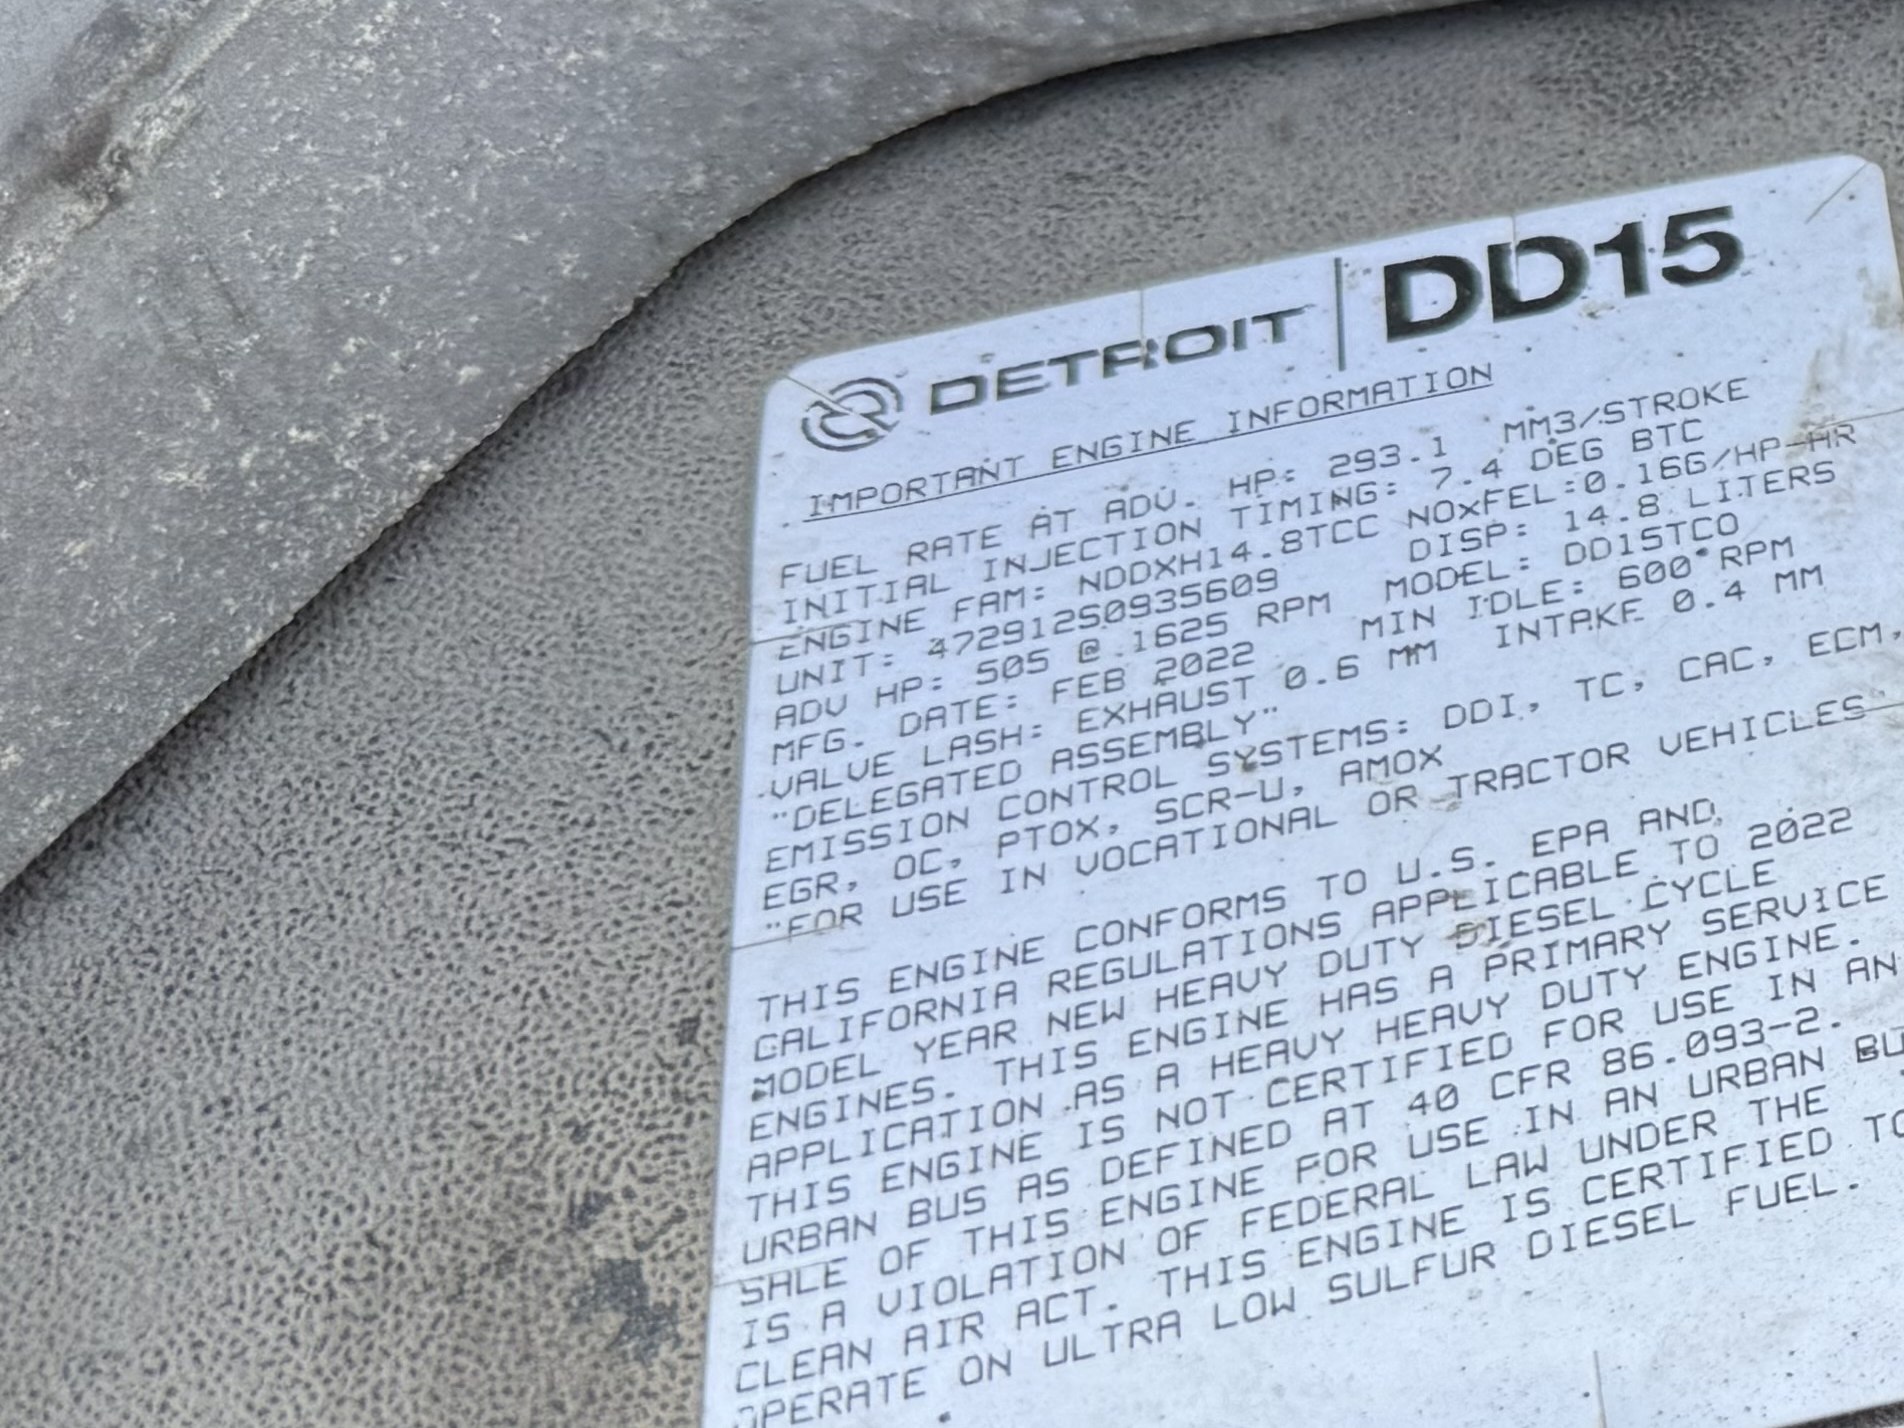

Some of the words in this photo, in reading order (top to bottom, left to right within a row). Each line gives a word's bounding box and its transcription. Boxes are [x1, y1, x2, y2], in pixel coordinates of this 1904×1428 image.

[929, 302, 1310, 417] DETROIT
[1382, 203, 1747, 344] DD15
[780, 552, 878, 589] FUEL
[906, 523, 1001, 566] RATE
[1030, 506, 1075, 539] AT
[1228, 467, 1294, 498] HP:
[1328, 434, 1446, 479] 293.1
[1503, 375, 1748, 444] MM3/STROKE
[783, 571, 950, 625] INITIAL
[984, 515, 1201, 582] INJECTION
[1430, 456, 1503, 491] 7.4
[1528, 435, 1603, 472] DEG
[1630, 417, 1703, 453] BTC
[807, 453, 1023, 520] IMPORTANT
[1052, 418, 1195, 469] ENGINE
[1228, 361, 1491, 434] INFORMATION
[772, 726, 864, 765] MFG.
[899, 692, 1016, 738] DATE:
[1052, 666, 1125, 705] FEB
[1152, 639, 1253, 687] 2022
[1360, 603, 1434, 641] MIN
[1617, 553, 1692, 591] 600
[1719, 534, 1794, 571] RPM
[774, 693, 846, 730] ADV
[875, 674, 941, 708] HP:
[1256, 590, 1330, 628] RPM
[776, 650, 892, 696] UNIT:
[1408, 521, 1526, 564] DISP:
[1565, 492, 1659, 533] 14.8
[953, 585, 1043, 622] FAM:
[1078, 512, 1378, 596] NDDXH14.8TCC
[764, 805, 968, 873] EMISSION
[998, 764, 1176, 822] CONTROL
[1443, 691, 1539, 731] DDI,
[1574, 670, 1643, 702] TC,
[1678, 644, 1773, 683] CAC,
[1807, 620, 1901, 658] ECM,
[771, 750, 894, 801] VALVE
[922, 722, 1041, 767] LASH:
[1077, 673, 1254, 735] EXHAUST
[1284, 653, 1359, 691] 0.6
[1671, 578, 1746, 614] 0.4
[1773, 563, 1823, 595] MM
[756, 975, 859, 1023] THIS
[889, 934, 1044, 995] ENGINE
[1075, 883, 1286, 954] CONFORMS
[1316, 867, 1366, 901] TO
[1396, 844, 1495, 886] U.S.
[1530, 817, 1609, 859] EPA
[762, 869, 857, 911] EGR,
[893, 846, 960, 881] OC,
[997, 813, 1118, 859] PTOX,
[1154, 775, 1303, 826] SCR-U,
[1339, 742, 1442, 787] AMOX
[891, 877, 966, 919] USE
[1000, 860, 1045, 895] IN
[1075, 804, 1337, 877] VOCATIONAL
[1366, 783, 1417, 818] OR
[1048, 909, 1341, 998] REGULATIONS
[1668, 832, 1719, 866] TO
[1747, 805, 1852, 852] 2022
[746, 1091, 1041, 1184] APPLICATION
[1155, 1061, 1178, 1093] A
[1210, 1026, 1344, 1082] HEAVY
[1375, 990, 1510, 1046] HEAVY
[1540, 962, 1648, 1011] DUTY
[1677, 921, 1859, 982] ENGINE.
[749, 1074, 954, 1143] ENGINES.
[992, 1039, 1096, 1087] THIS
[1128, 997, 1288, 1060] ENGINE
[1319, 975, 1398, 1018] HAS
[1427, 963, 1453, 994] A
[1483, 917, 1671, 983] PRIMARY
[1701, 872, 1888, 937] SERVICE
[913, 1018, 1016, 1065] YEAR
[1047, 995, 1124, 1037] NEW
[1155, 959, 1287, 1014] HEAVY
[1317, 932, 1424, 979] DUTY
[1641, 857, 1777, 913] CYCLE
[742, 1209, 876, 1266] URBAN
[906, 1184, 986, 1230] BUS
[1018, 1166, 1068, 1205] AS
[1101, 1117, 1291, 1187] DEFINED
[1322, 1098, 1374, 1138] AT
[1406, 1081, 1459, 1117] 40
[1490, 1057, 1571, 1102] CFR
[1601, 1004, 1841, 1078] 86.093-2.
[745, 1174, 850, 1223] THIS
[881, 1131, 1041, 1194] ENGINE
[1078, 1113, 1124, 1151] IS
[1156, 1089, 1234, 1133] NOT
[1266, 1029, 1512, 1110] CERTIFIED
[1543, 1006, 1623, 1050] FOR
[1653, 982, 1734, 1027] USE
[1767, 967, 1816, 1002] IN
[1845, 950, 1897, 986] AN
[879, 1237, 930, 1277] OF
[962, 1206, 1068, 1257] THIS
[1100, 1163, 1264, 1228] ENGINE
[1408, 1115, 1489, 1161] USE
[1604, 1080, 1657, 1118] AN
[1687, 1044, 1824, 1100] URBAN
[735, 1336, 871, 1395] CLEAN
[904, 1309, 983, 1357] AIR
[1016, 1283, 1117, 1332] ACT.
[1157, 1247, 1266, 1299] THIS
[1298, 1202, 1465, 1270] ENGINE
[1501, 1185, 1550, 1224] IS
[1581, 1125, 1833, 1207] CERTIFIED
[743, 1312, 790, 1350] IS
[821, 1300, 845, 1332] A
[877, 1237, 1124, 1318] VIOLATION
[1156, 1217, 1208, 1258] OF
[1240, 1169, 1434, 1240] FEDERAL
[1466, 1143, 1548, 1190] LAW
[1578, 1107, 1717, 1166] UNDER
[1747, 1082, 1828, 1127] THE
[959, 1348, 1010, 1388] ON
[1044, 1308, 1181, 1369] ULTRA
[1213, 1285, 1294, 1331] LOW
[1327, 1239, 1496, 1306] SULFUR
[1526, 1200, 1695, 1261] DIESEL
[1724, 1170, 1858, 1218] FUEL.
